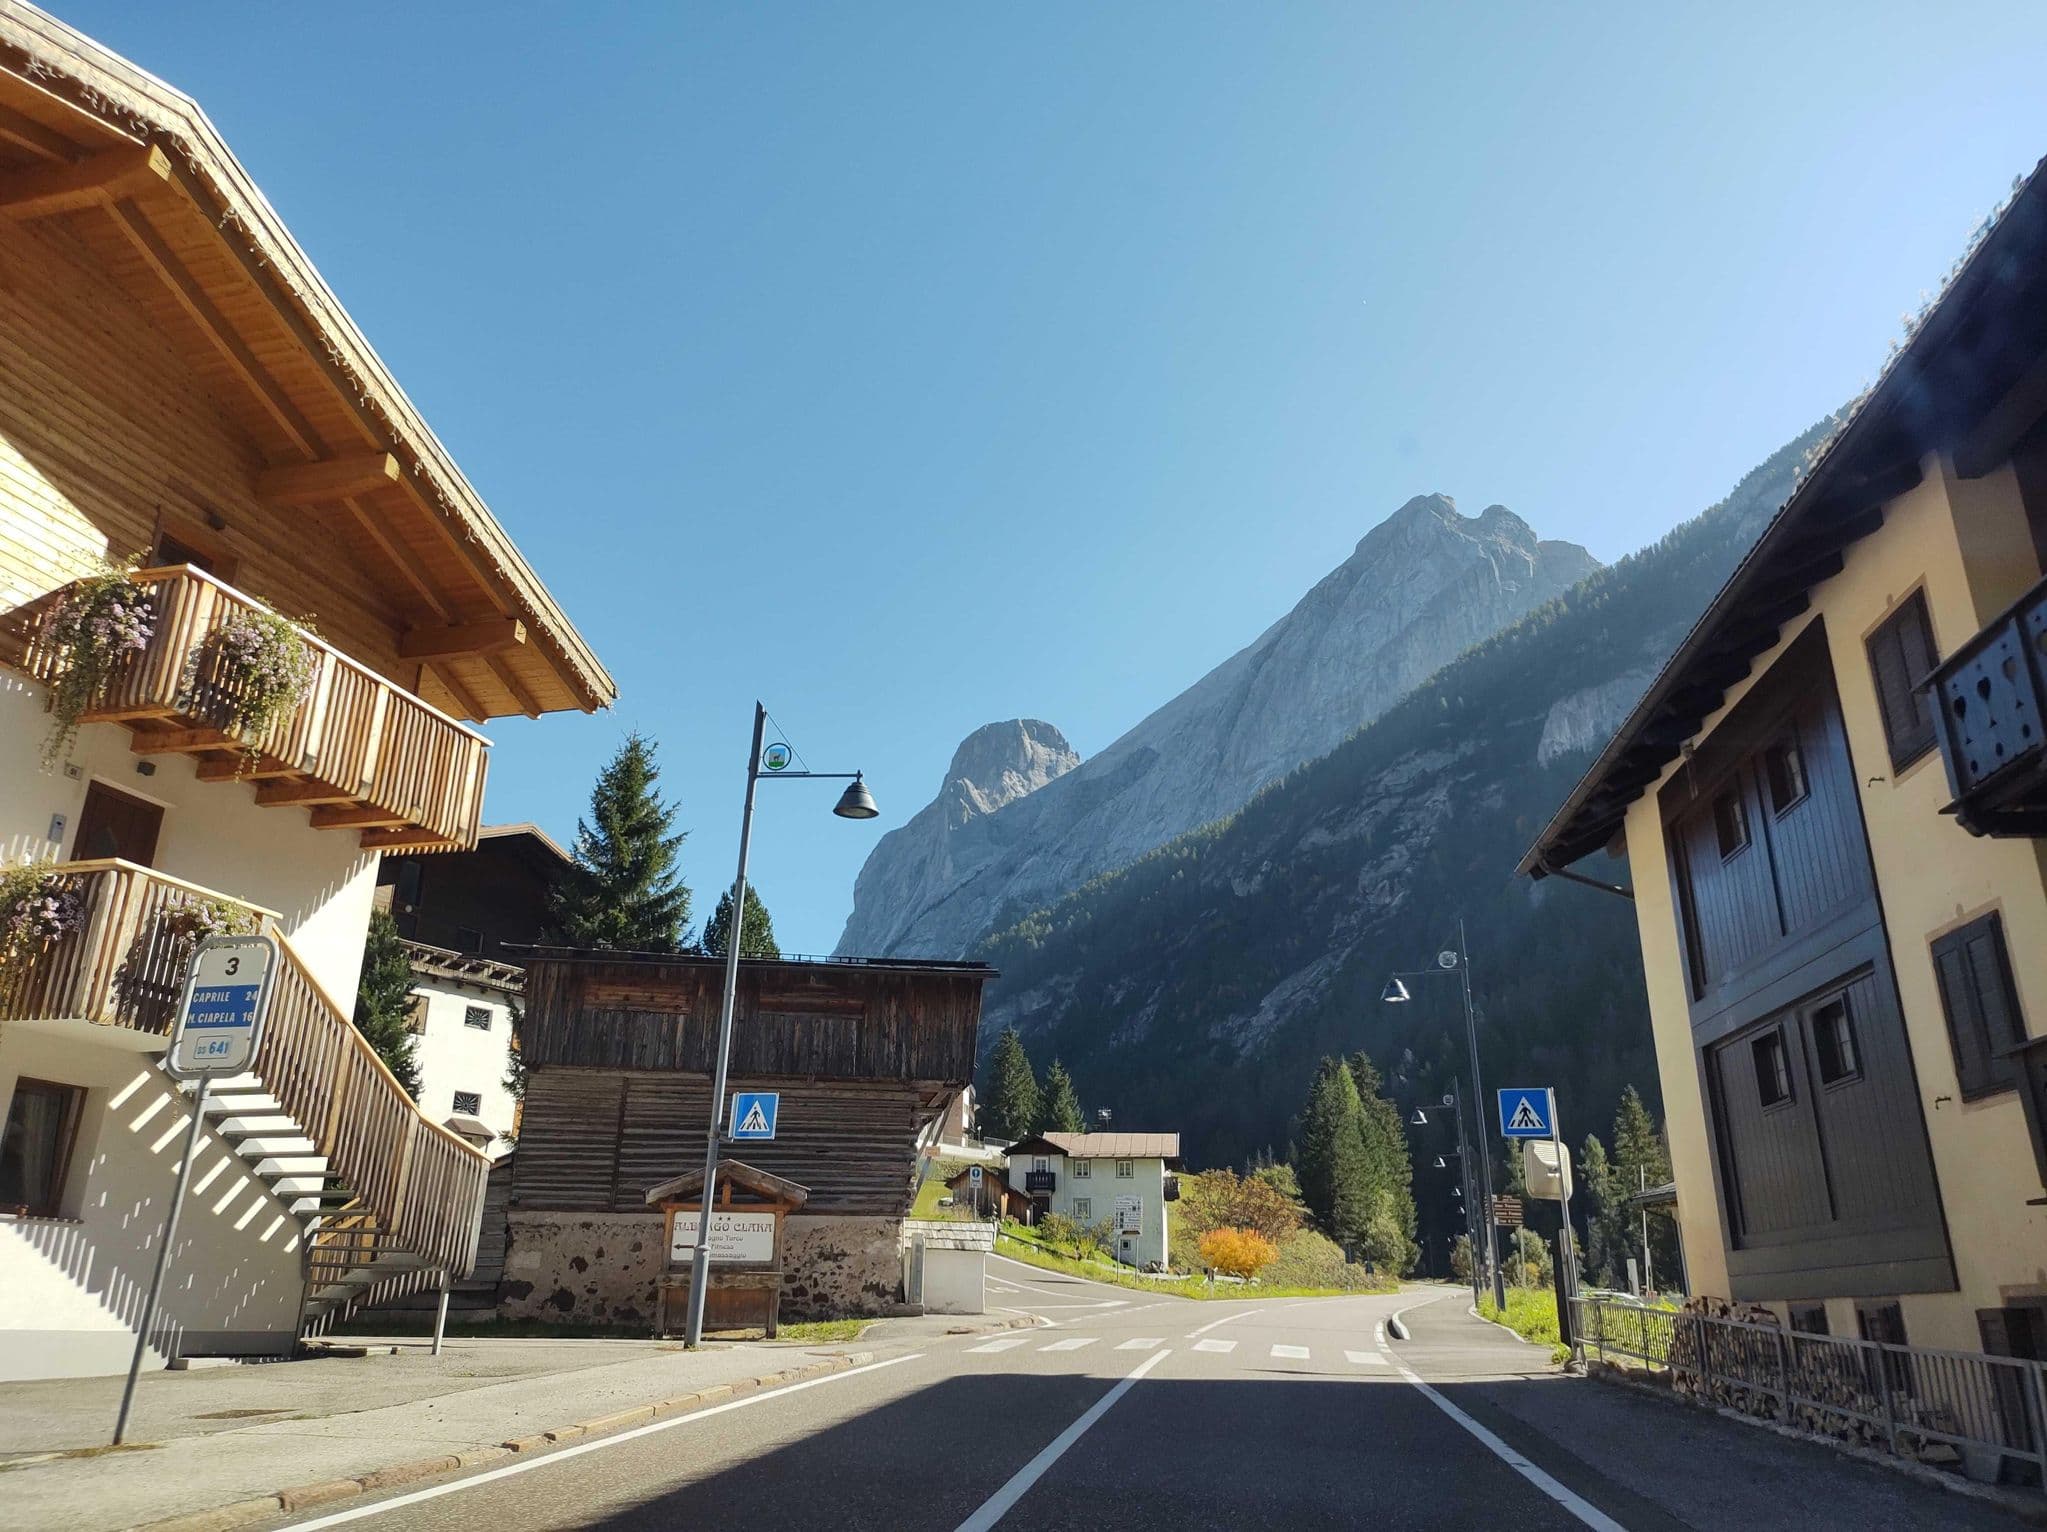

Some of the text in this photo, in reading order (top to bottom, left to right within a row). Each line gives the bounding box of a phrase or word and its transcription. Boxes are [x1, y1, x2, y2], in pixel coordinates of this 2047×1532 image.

[225, 957, 240, 976] 3
[193, 990, 258, 1002] CAPRILE 24
[197, 1012, 236, 1023] CIAPELA
[242, 1011, 253, 1022] 16
[208, 1041, 229, 1055] 641
[733, 1222, 773, 1232] CLARA
